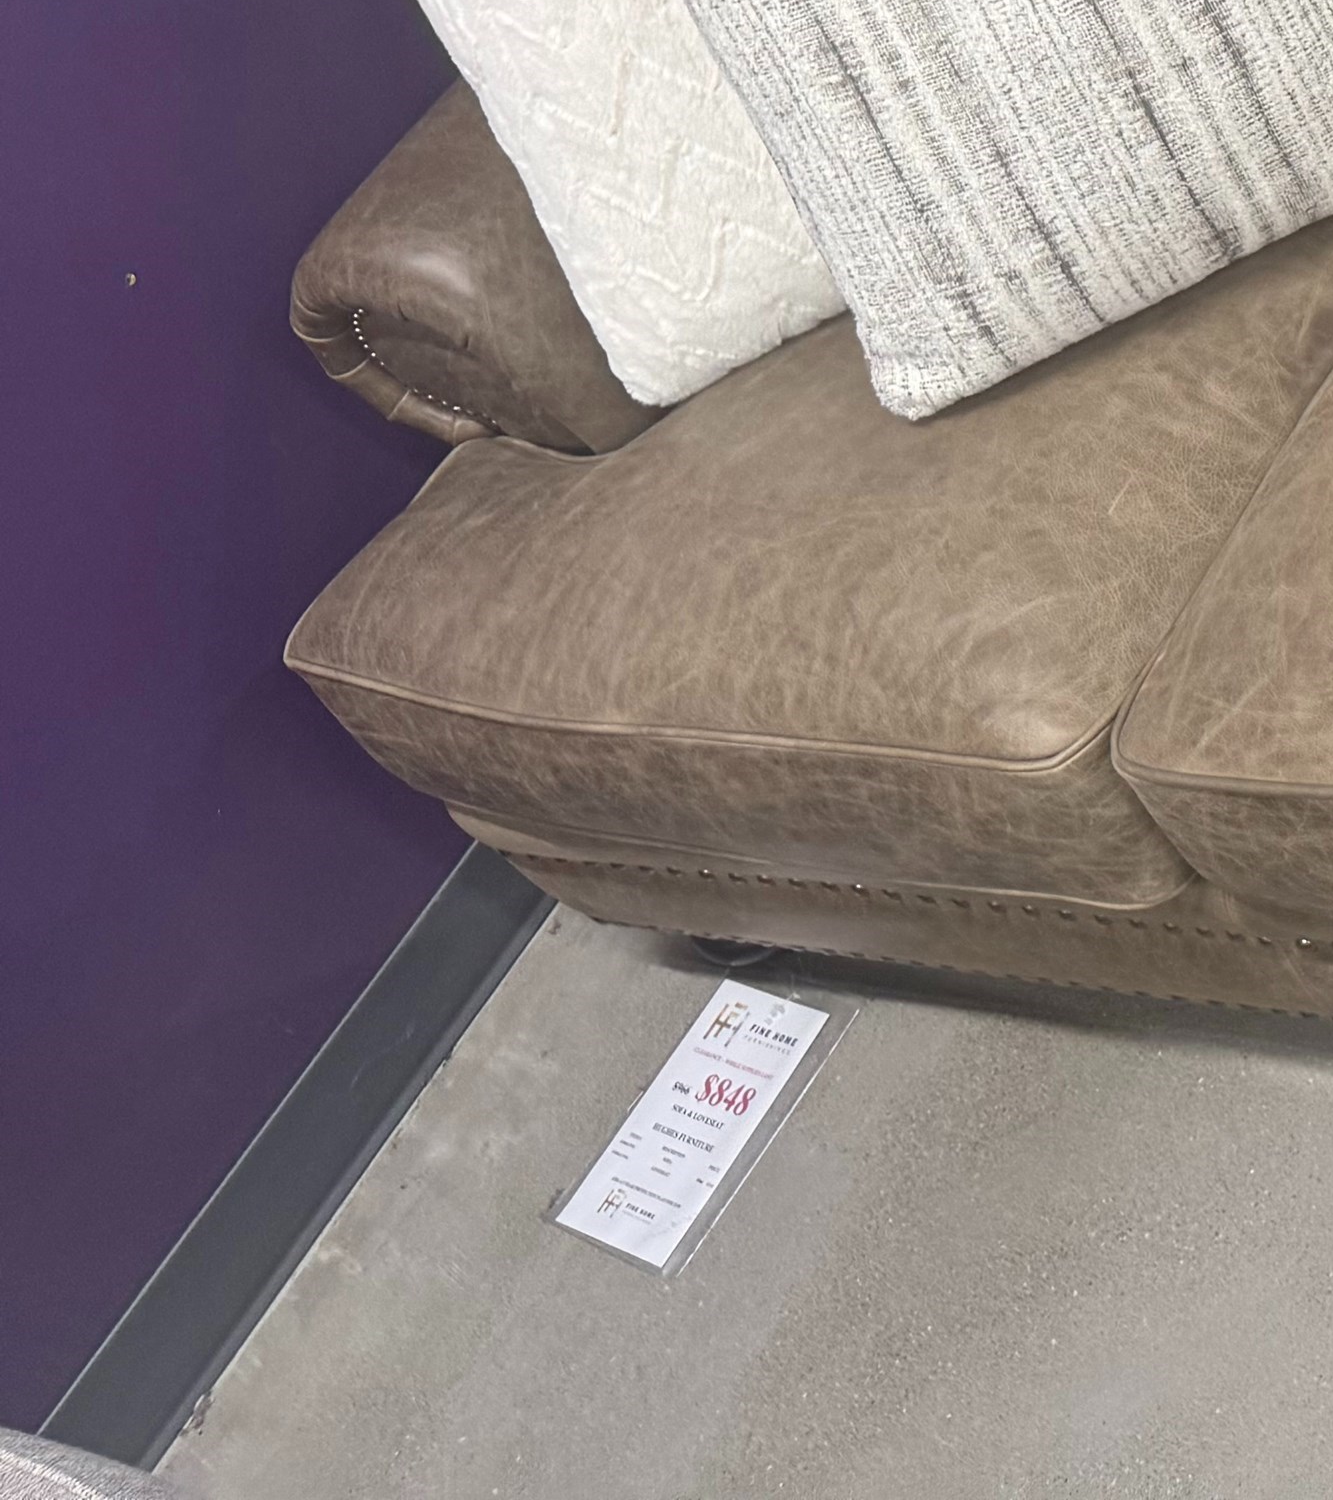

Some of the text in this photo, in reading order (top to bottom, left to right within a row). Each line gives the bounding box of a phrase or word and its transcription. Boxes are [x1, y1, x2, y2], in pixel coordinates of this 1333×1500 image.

[749, 1024, 798, 1047] FINE HOME
[694, 1074, 757, 1116] $848
